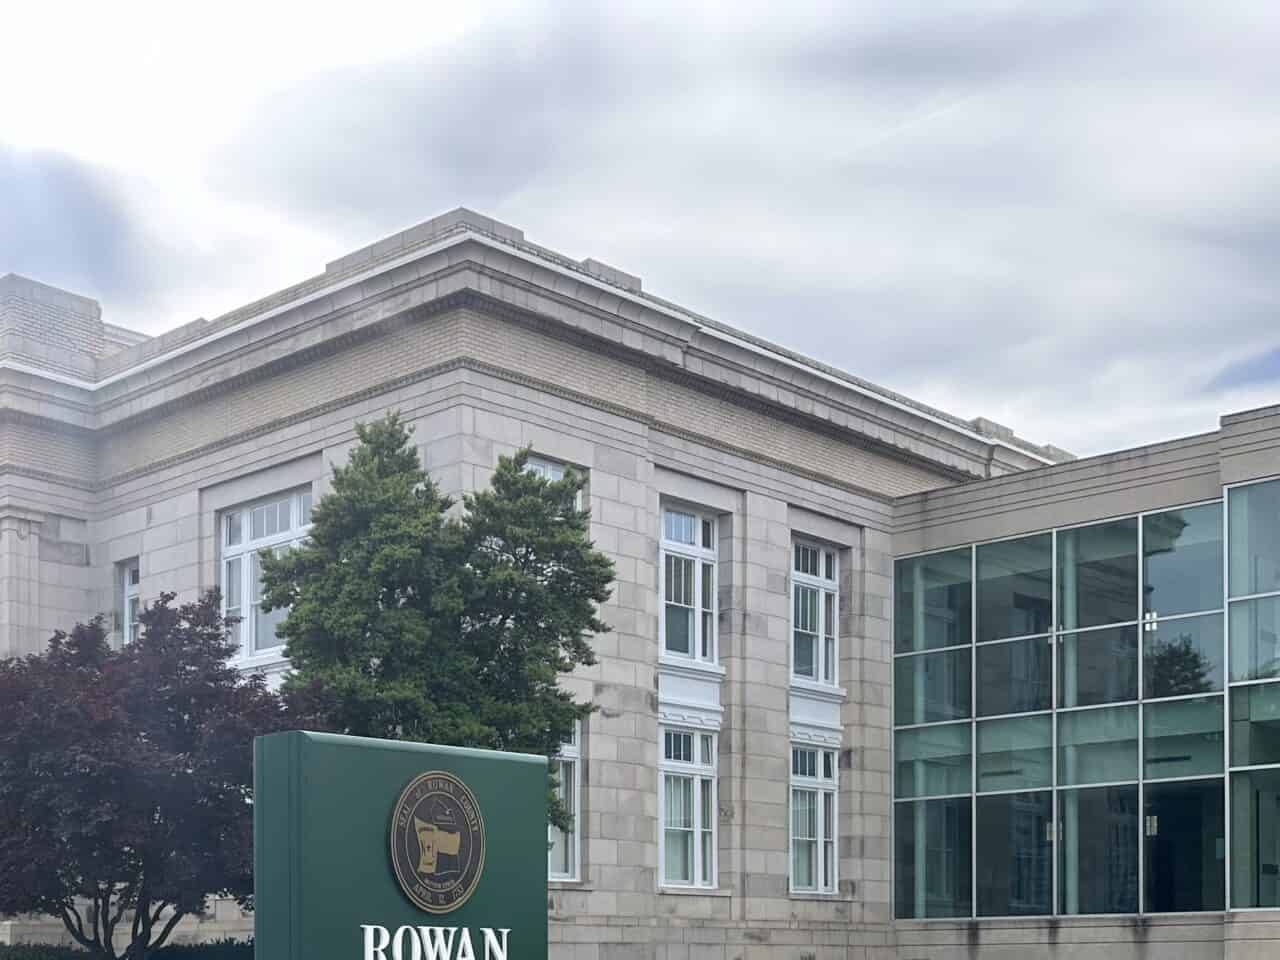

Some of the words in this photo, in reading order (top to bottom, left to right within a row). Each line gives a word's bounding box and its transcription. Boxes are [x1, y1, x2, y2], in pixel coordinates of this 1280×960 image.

[399, 805, 412, 831] SEAL
[427, 779, 455, 793] ROWAN
[461, 795, 479, 832] COUNTY
